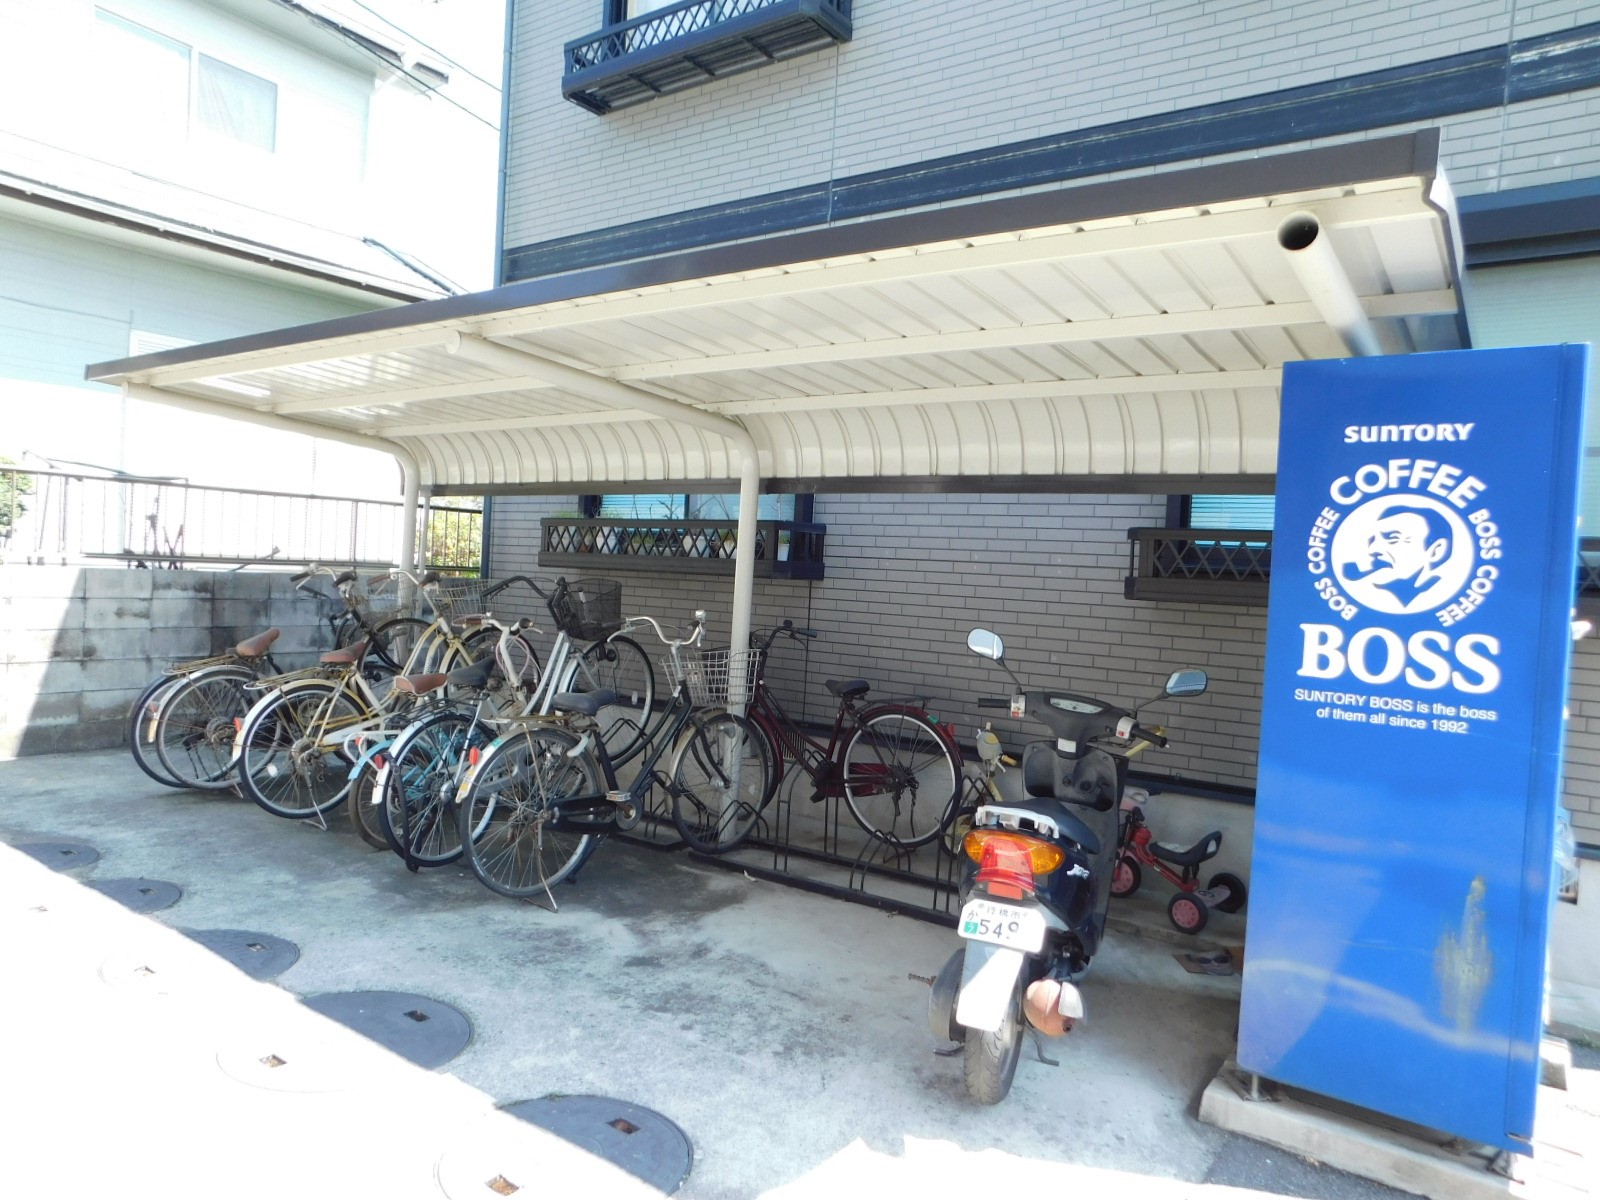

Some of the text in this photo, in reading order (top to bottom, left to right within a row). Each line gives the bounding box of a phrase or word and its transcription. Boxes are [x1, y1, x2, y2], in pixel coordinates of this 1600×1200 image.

[1329, 458, 1487, 509] COFFEE
[1307, 506, 1359, 621] BOSS COFFEE
[1435, 508, 1503, 627] BOSS COFFEE
[1296, 622, 1502, 695] BOSS
[1294, 688, 1498, 721] SUNTORY BOSS is the boss
[1316, 706, 1469, 734] of them all since 1992
